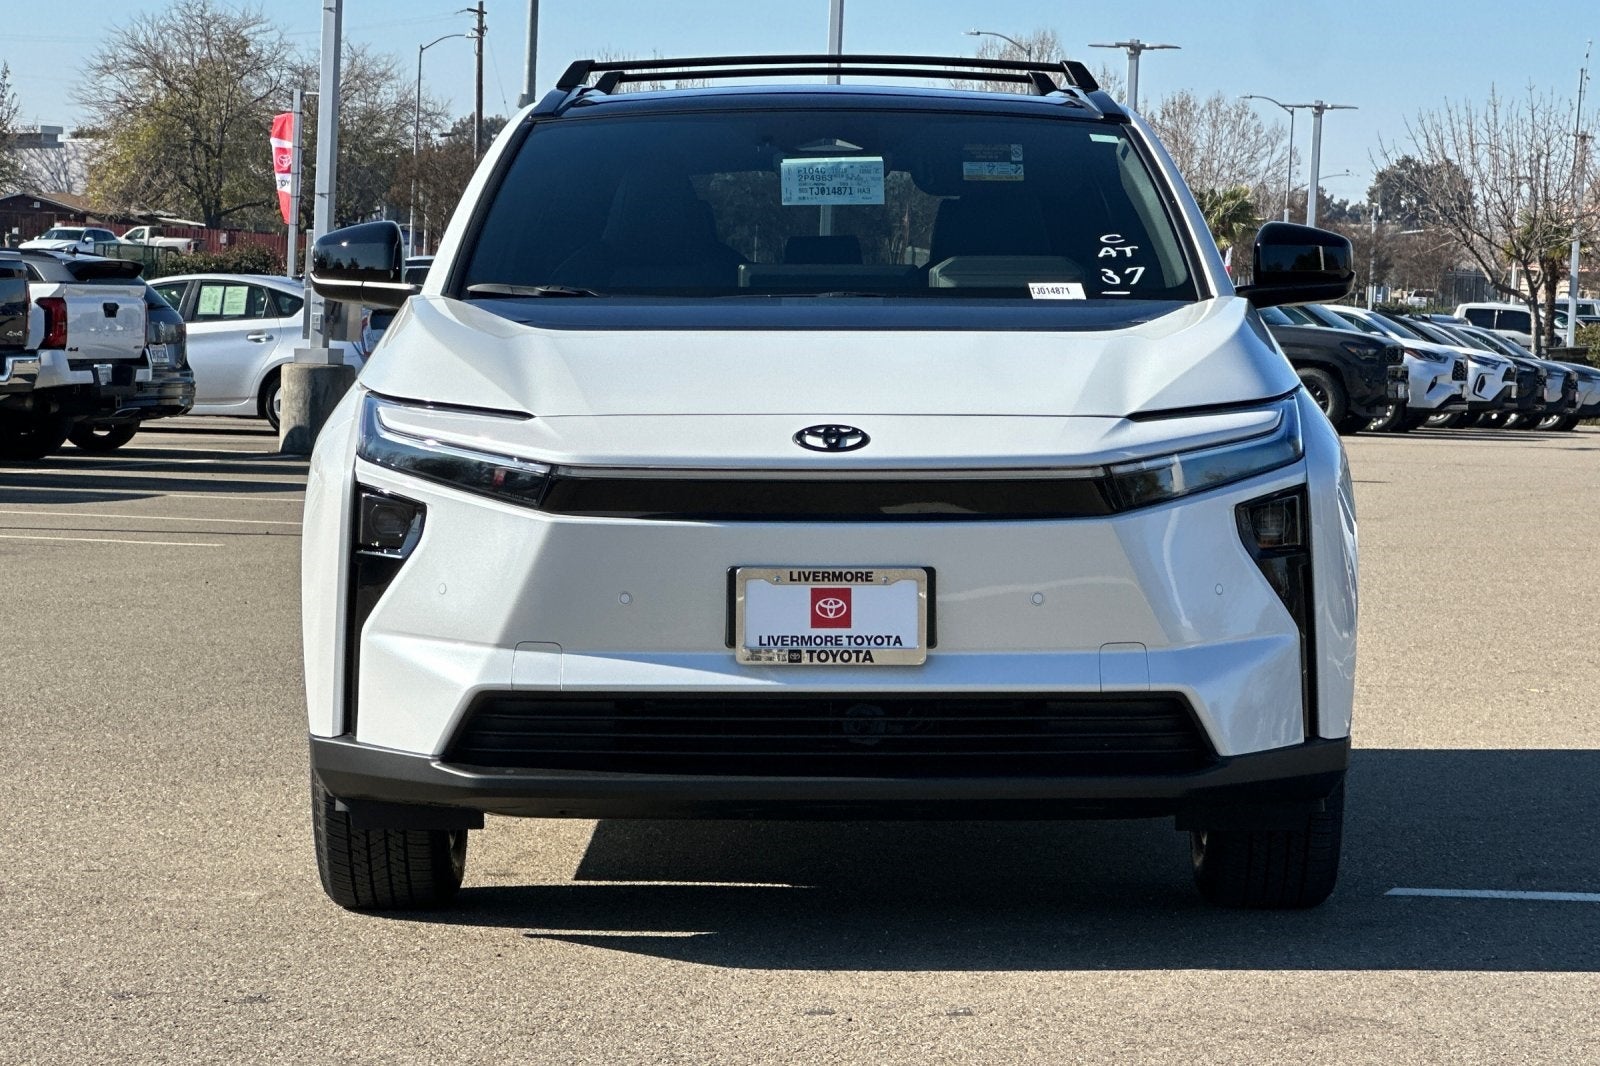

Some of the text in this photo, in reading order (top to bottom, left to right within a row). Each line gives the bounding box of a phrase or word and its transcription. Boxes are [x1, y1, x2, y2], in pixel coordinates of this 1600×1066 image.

[809, 187, 853, 196] TJ014871
[1097, 245, 1139, 258] AT
[1100, 266, 1146, 285] 37
[1031, 287, 1071, 295] TJ014871
[789, 571, 874, 583] LIVERMORE
[758, 635, 903, 647] LIVERMORE TOYOTA
[806, 650, 875, 663] TOYOTA
